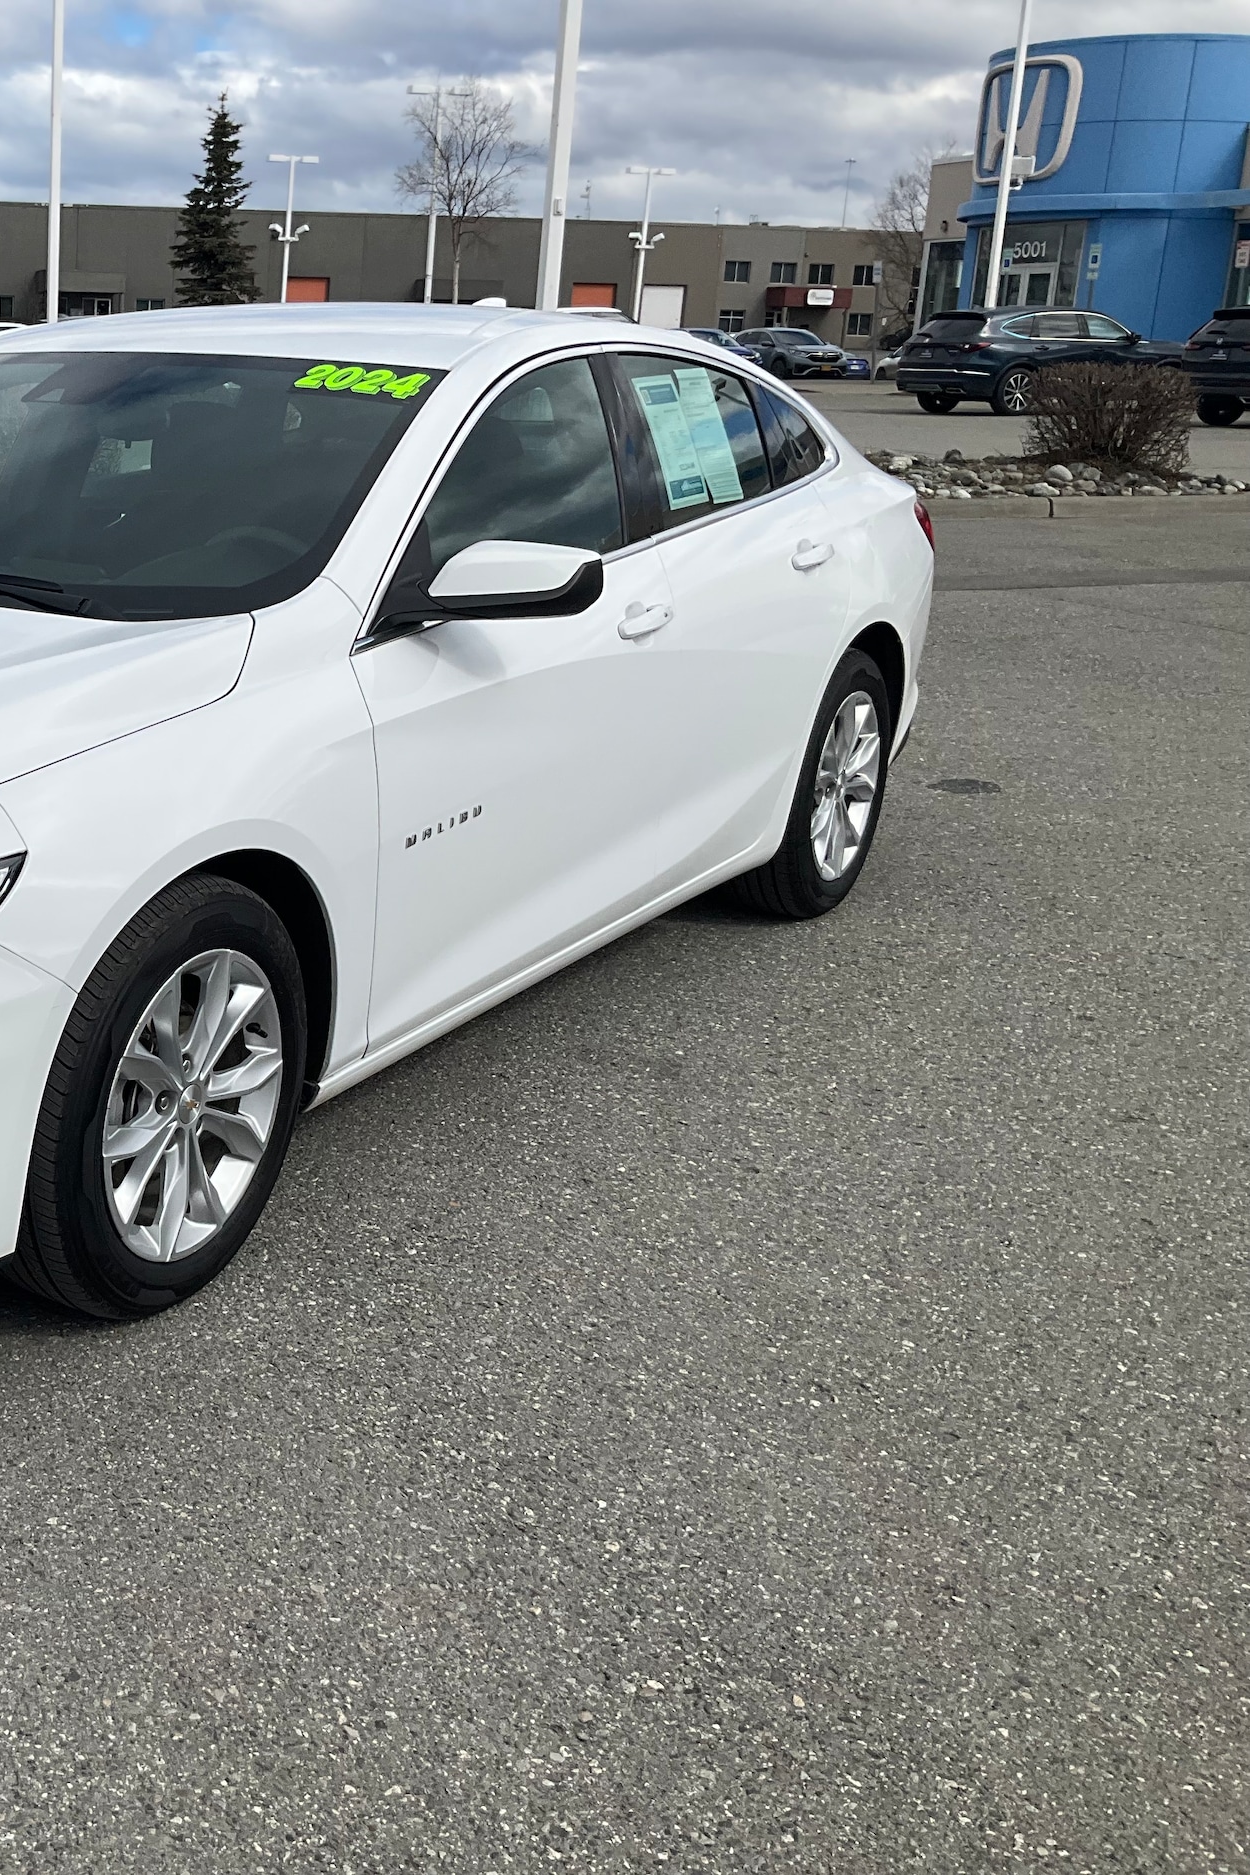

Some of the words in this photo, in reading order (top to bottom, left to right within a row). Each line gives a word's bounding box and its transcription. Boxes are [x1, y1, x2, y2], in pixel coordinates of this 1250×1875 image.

[1013, 241, 1047, 259] 5001
[294, 364, 431, 399] 2024
[405, 804, 482, 849] MALIBU
